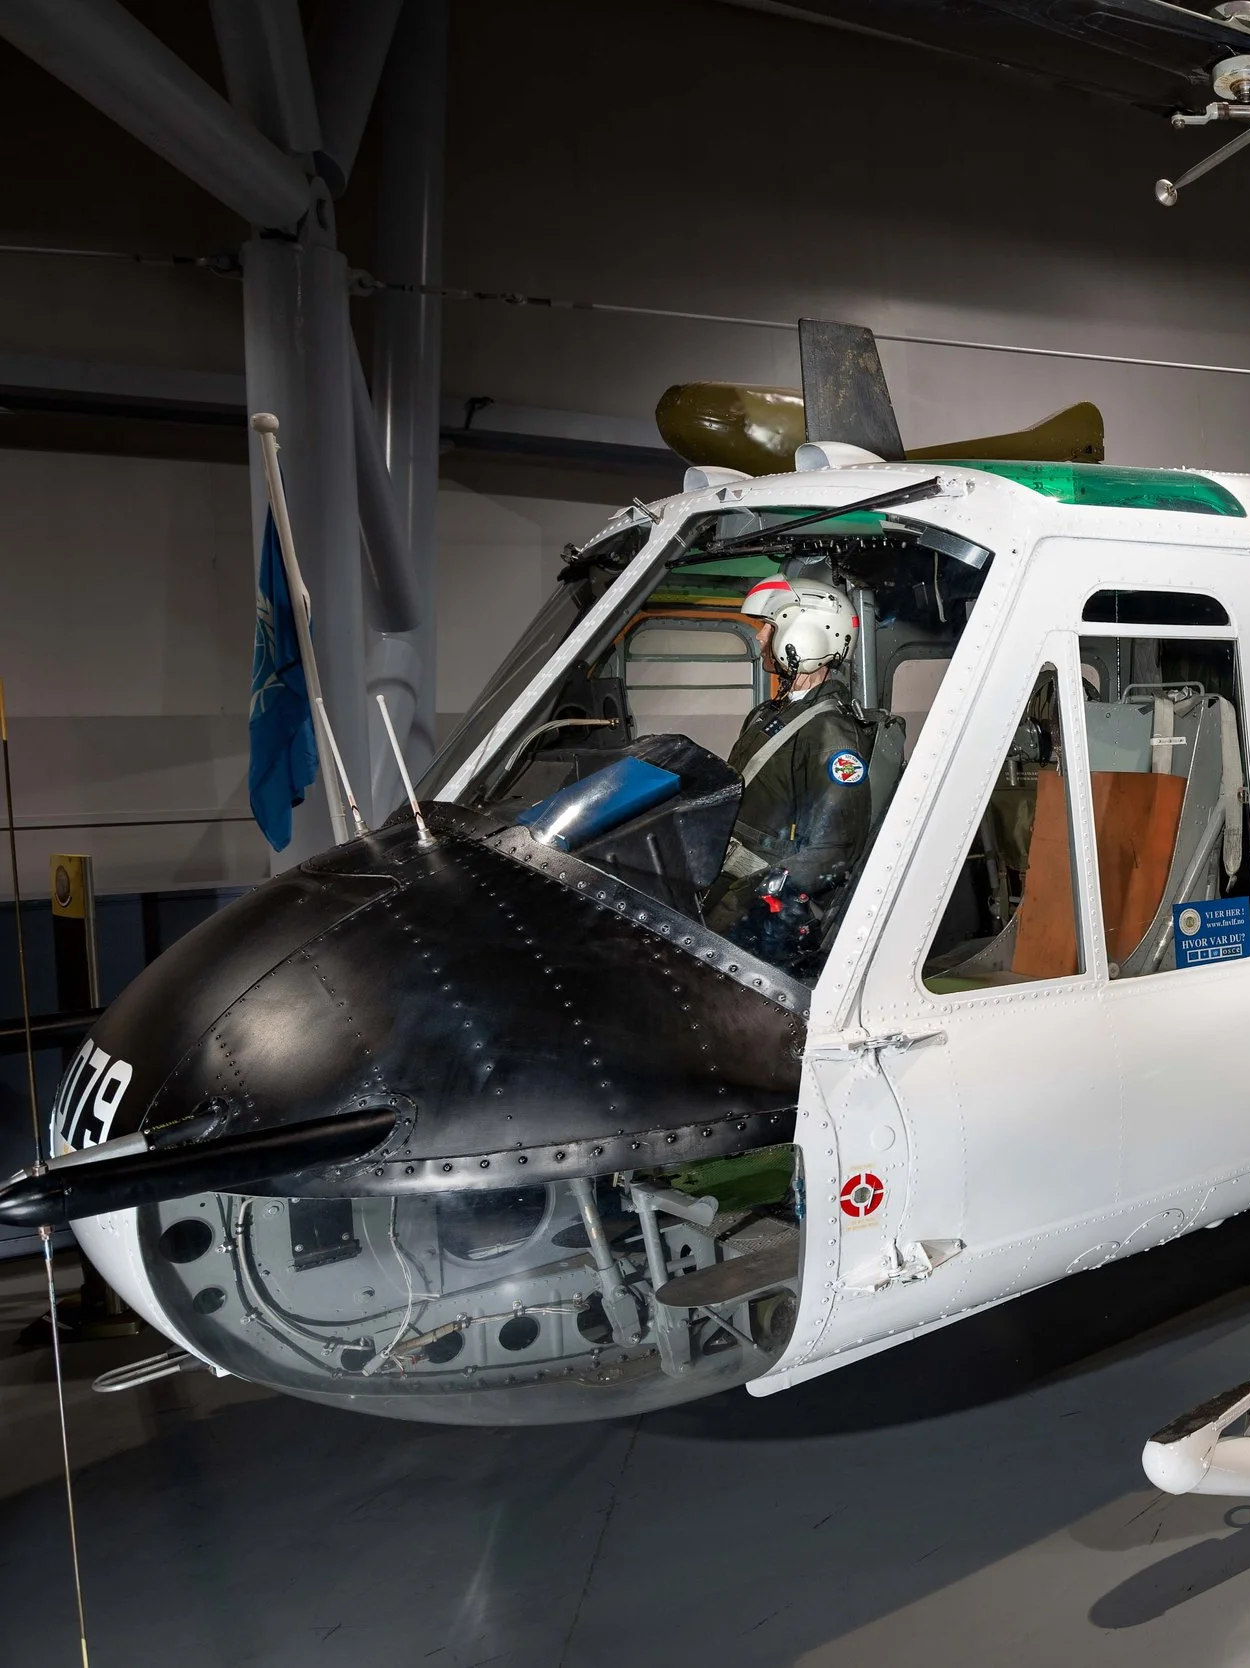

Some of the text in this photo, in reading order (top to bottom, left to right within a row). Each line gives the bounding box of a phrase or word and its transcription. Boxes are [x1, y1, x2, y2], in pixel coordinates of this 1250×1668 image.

[1205, 911, 1214, 919] VI
[1214, 910, 1225, 918] ER
[1226, 908, 1241, 917] HER
[1182, 932, 1246, 950] HVOR VAR DU?
[53, 1037, 133, 1153] 079
